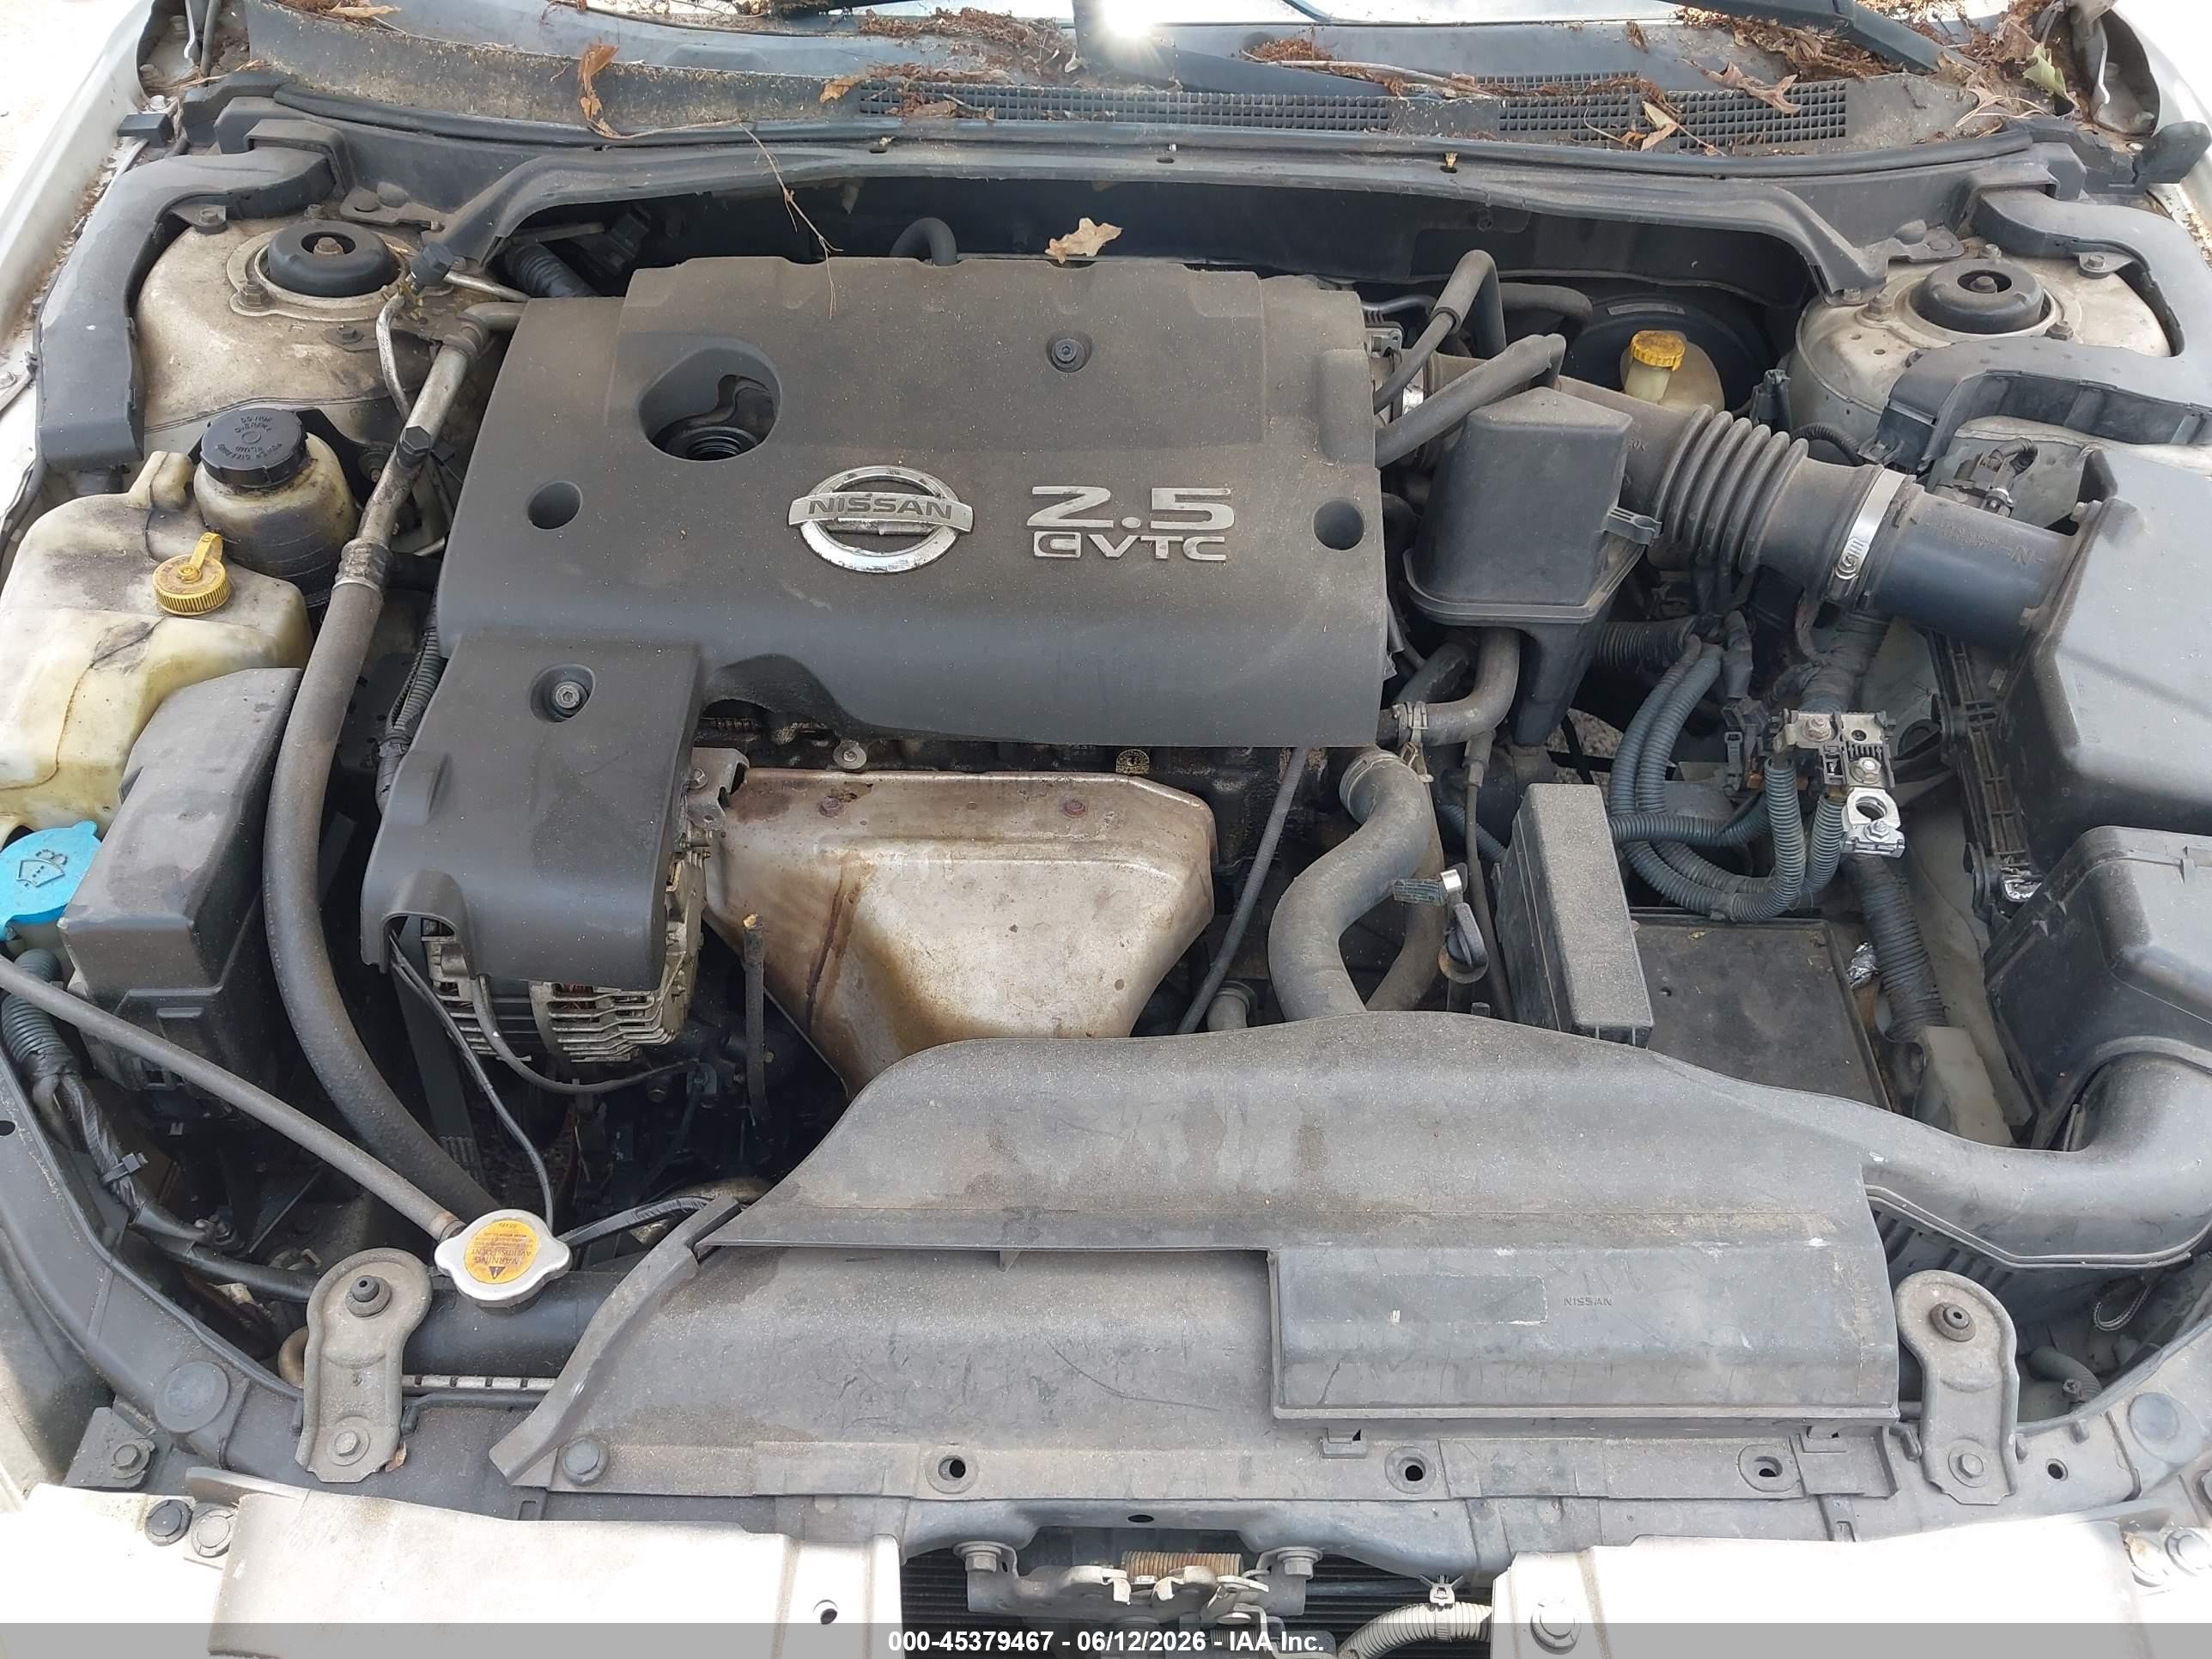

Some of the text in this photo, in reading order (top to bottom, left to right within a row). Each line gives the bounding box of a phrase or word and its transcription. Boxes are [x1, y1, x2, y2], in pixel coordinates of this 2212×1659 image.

[808, 497, 952, 520] NISSAN
[1026, 485, 1235, 531] 2.5
[1564, 1297, 1613, 1306] NISSAN
